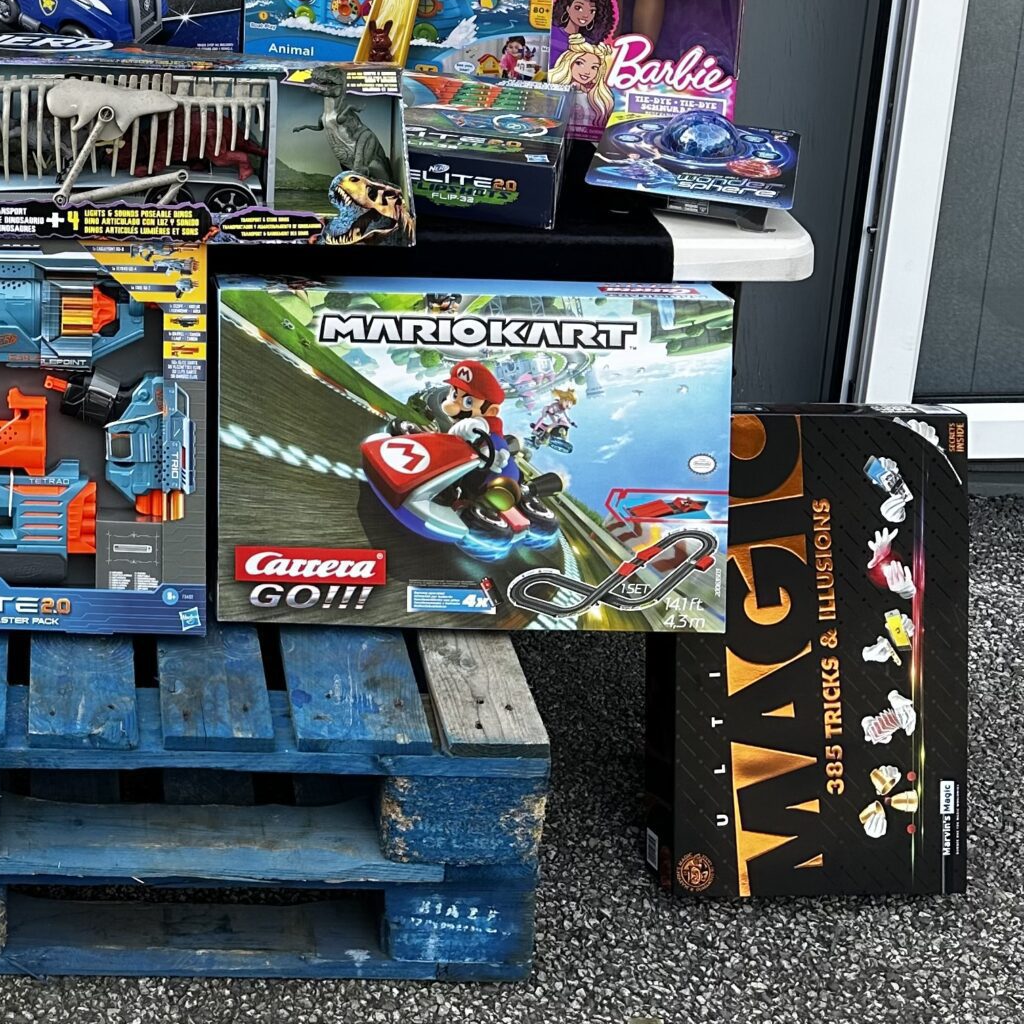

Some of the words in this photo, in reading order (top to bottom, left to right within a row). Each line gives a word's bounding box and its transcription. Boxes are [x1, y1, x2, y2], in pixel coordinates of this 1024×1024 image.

[533, 6, 550, 14] 80+
[268, 42, 315, 56] Animal
[608, 35, 732, 93] Barbie
[635, 95, 672, 106] TIE-DYE
[679, 100, 718, 110] TIE-DYE
[410, 169, 493, 189] ELITE
[493, 178, 517, 192] 2.0
[677, 181, 778, 198] sphere
[432, 192, 474, 204] FLIP-32
[4, 216, 45, 225] DINOSAURIO
[67, 210, 80, 231] 4
[84, 209, 106, 217] LIGHTS
[114, 209, 139, 218] SOUNDS
[141, 210, 172, 218] POSEABLE
[320, 313, 637, 350] MARIOKART
[956, 422, 965, 453] INSIDE
[29, 477, 70, 486] TETRAD
[242, 552, 376, 579] Carrera
[812, 497, 837, 622] ILLUSIONS
[40, 597, 71, 615] 2.0
[249, 584, 373, 609] GO!!!
[32, 616, 60, 626] PACK
[818, 627, 839, 649] &
[820, 655, 843, 740] TRICKS
[708, 670, 729, 827] ULTI
[825, 744, 845, 796] 385
[943, 784, 953, 812] Magic
[942, 815, 951, 856] Marvin's
